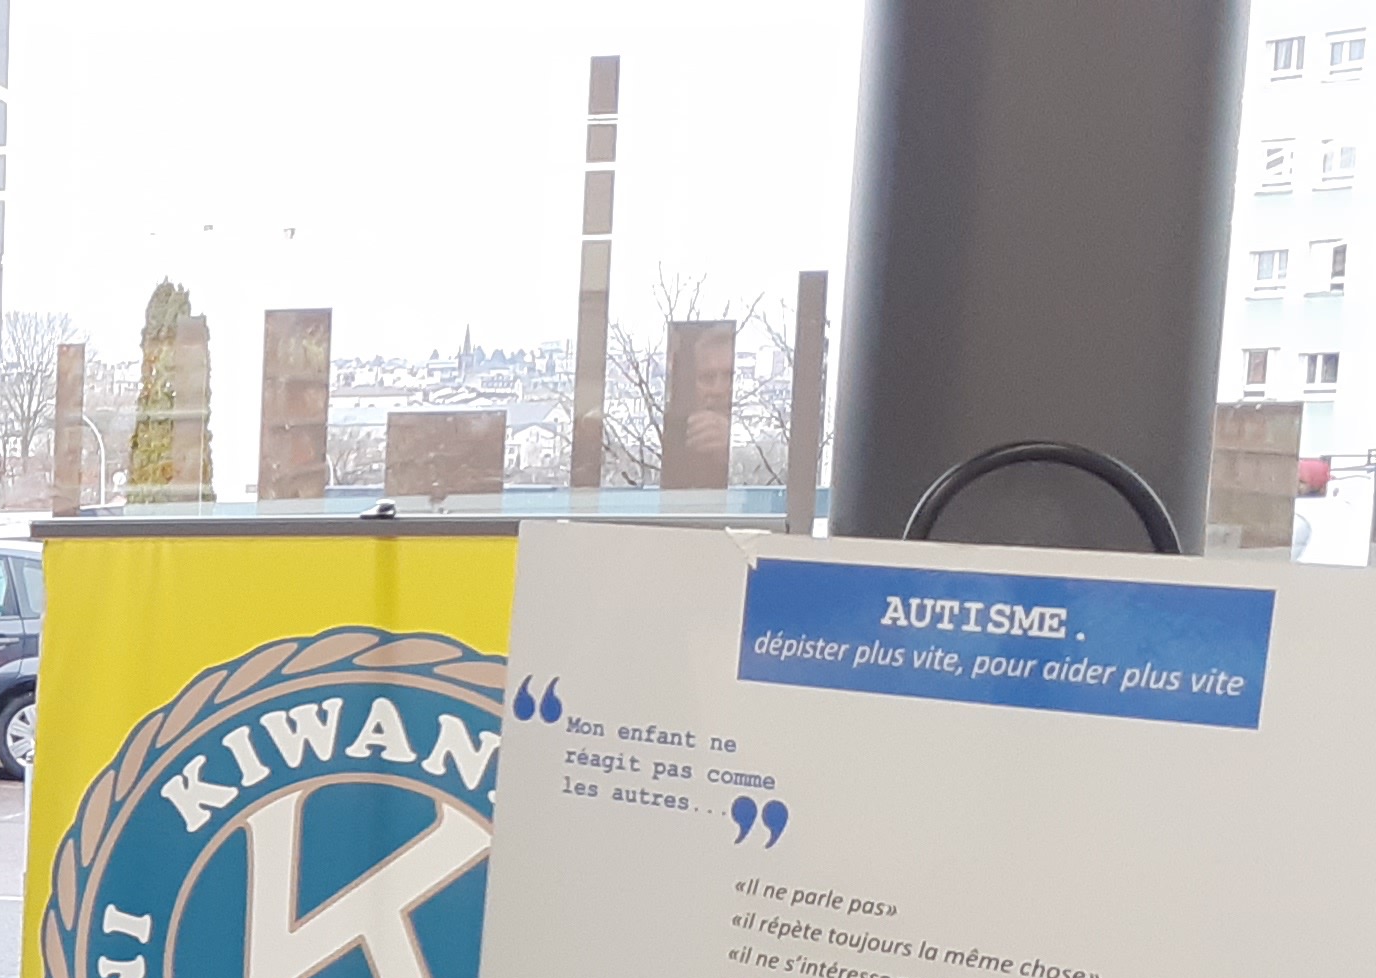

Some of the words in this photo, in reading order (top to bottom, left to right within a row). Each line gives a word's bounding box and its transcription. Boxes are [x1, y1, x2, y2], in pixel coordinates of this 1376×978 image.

[754, 630, 850, 661] dépister
[852, 640, 905, 668] plus
[912, 645, 963, 676] vite,
[971, 655, 1037, 680] pour
[1042, 656, 1117, 686] aider
[1120, 662, 1182, 693] plus
[1190, 668, 1246, 697] vite
[566, 716, 605, 738] Mon
[617, 724, 697, 748] enfant
[709, 735, 737, 753] ne
[160, 697, 502, 833] KIWAN
[564, 748, 641, 774] réagit
[652, 759, 693, 780] pas
[706, 767, 777, 790] comme
[561, 775, 599, 798] les
[763, 884, 788, 901] ne
[790, 888, 844, 910] parle
[847, 898, 898, 917] pas»
[755, 952, 780, 969] ne
[758, 915, 823, 943] répète
[827, 928, 913, 957] toujours
[917, 940, 938, 961] la
[943, 947, 1014, 974] même
